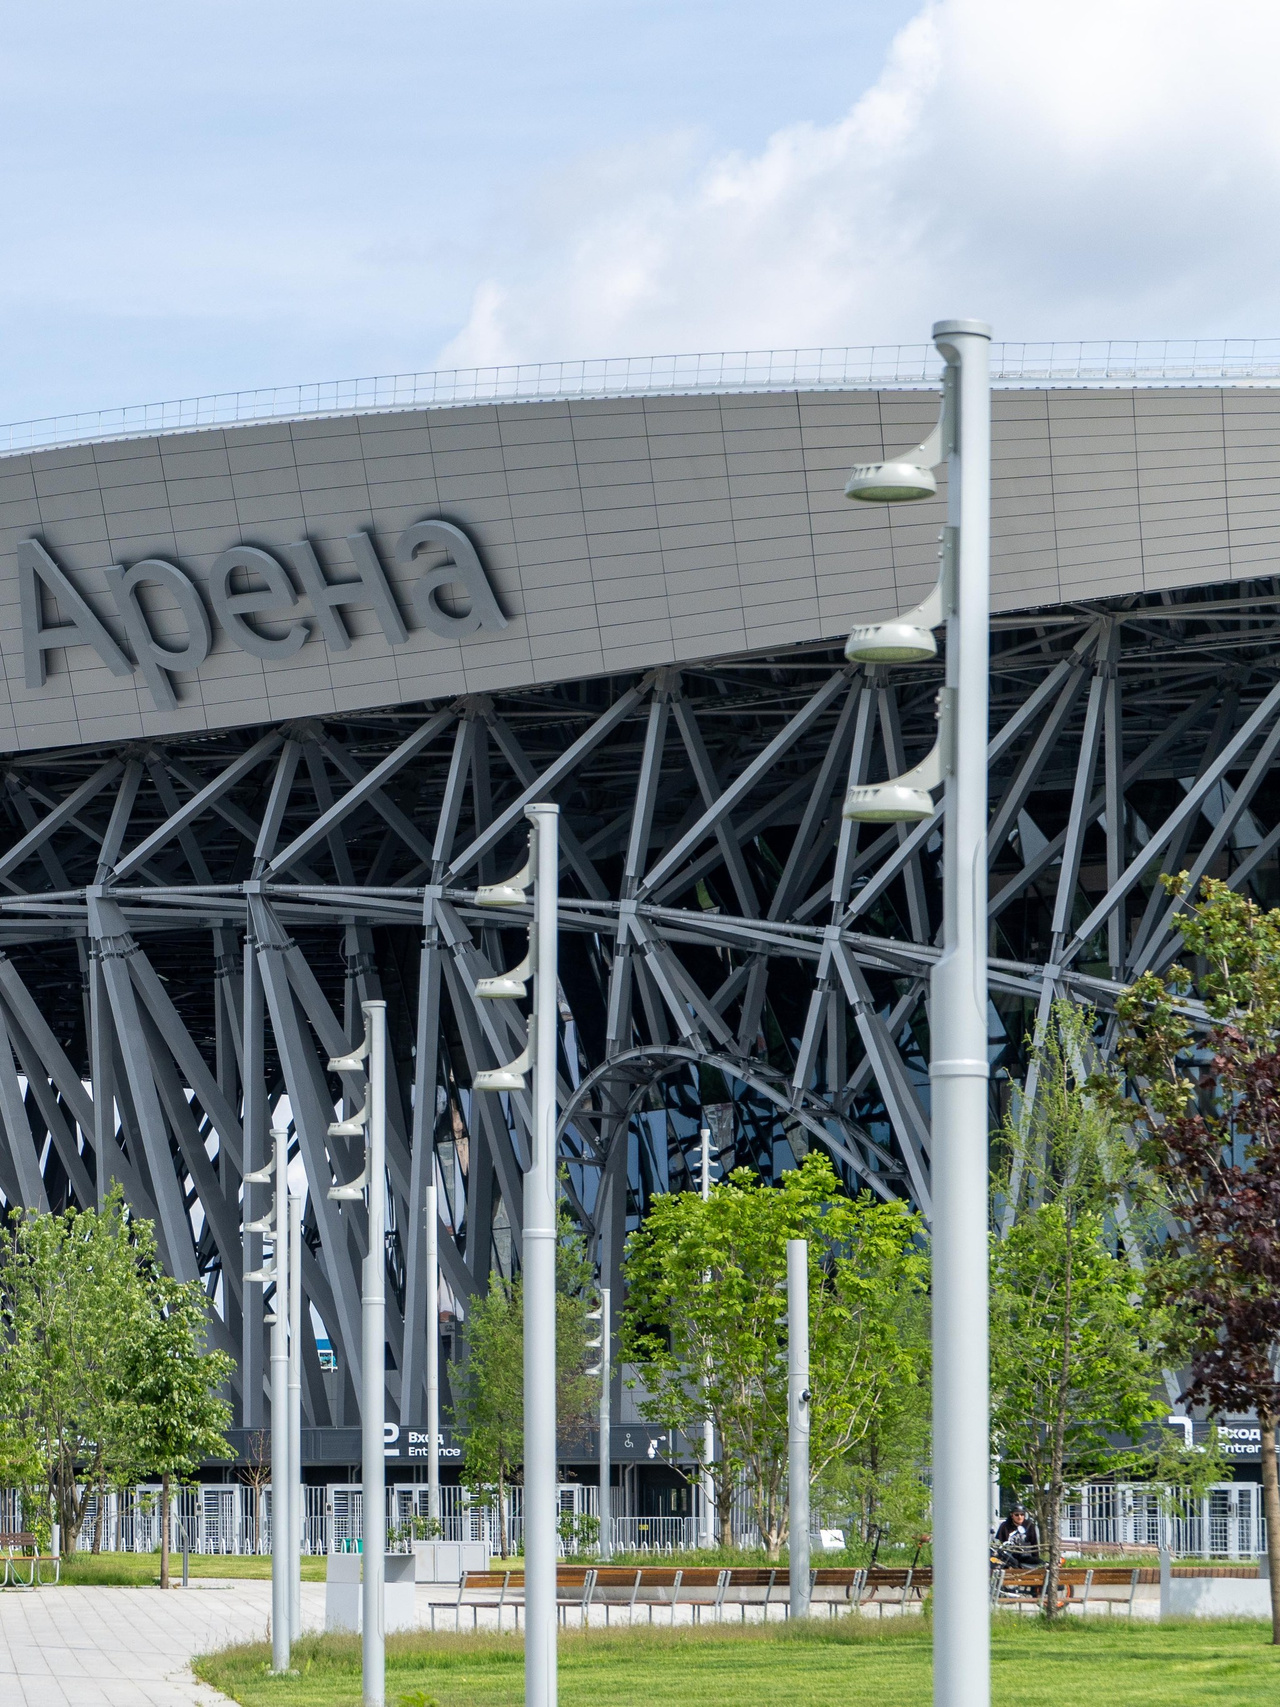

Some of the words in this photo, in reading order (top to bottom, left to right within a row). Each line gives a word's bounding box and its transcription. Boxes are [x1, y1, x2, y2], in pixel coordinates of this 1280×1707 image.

[16, 518, 510, 713] Арена
[408, 1446, 461, 1457] Entnce
[1218, 1442, 1280, 1454] Entrae
